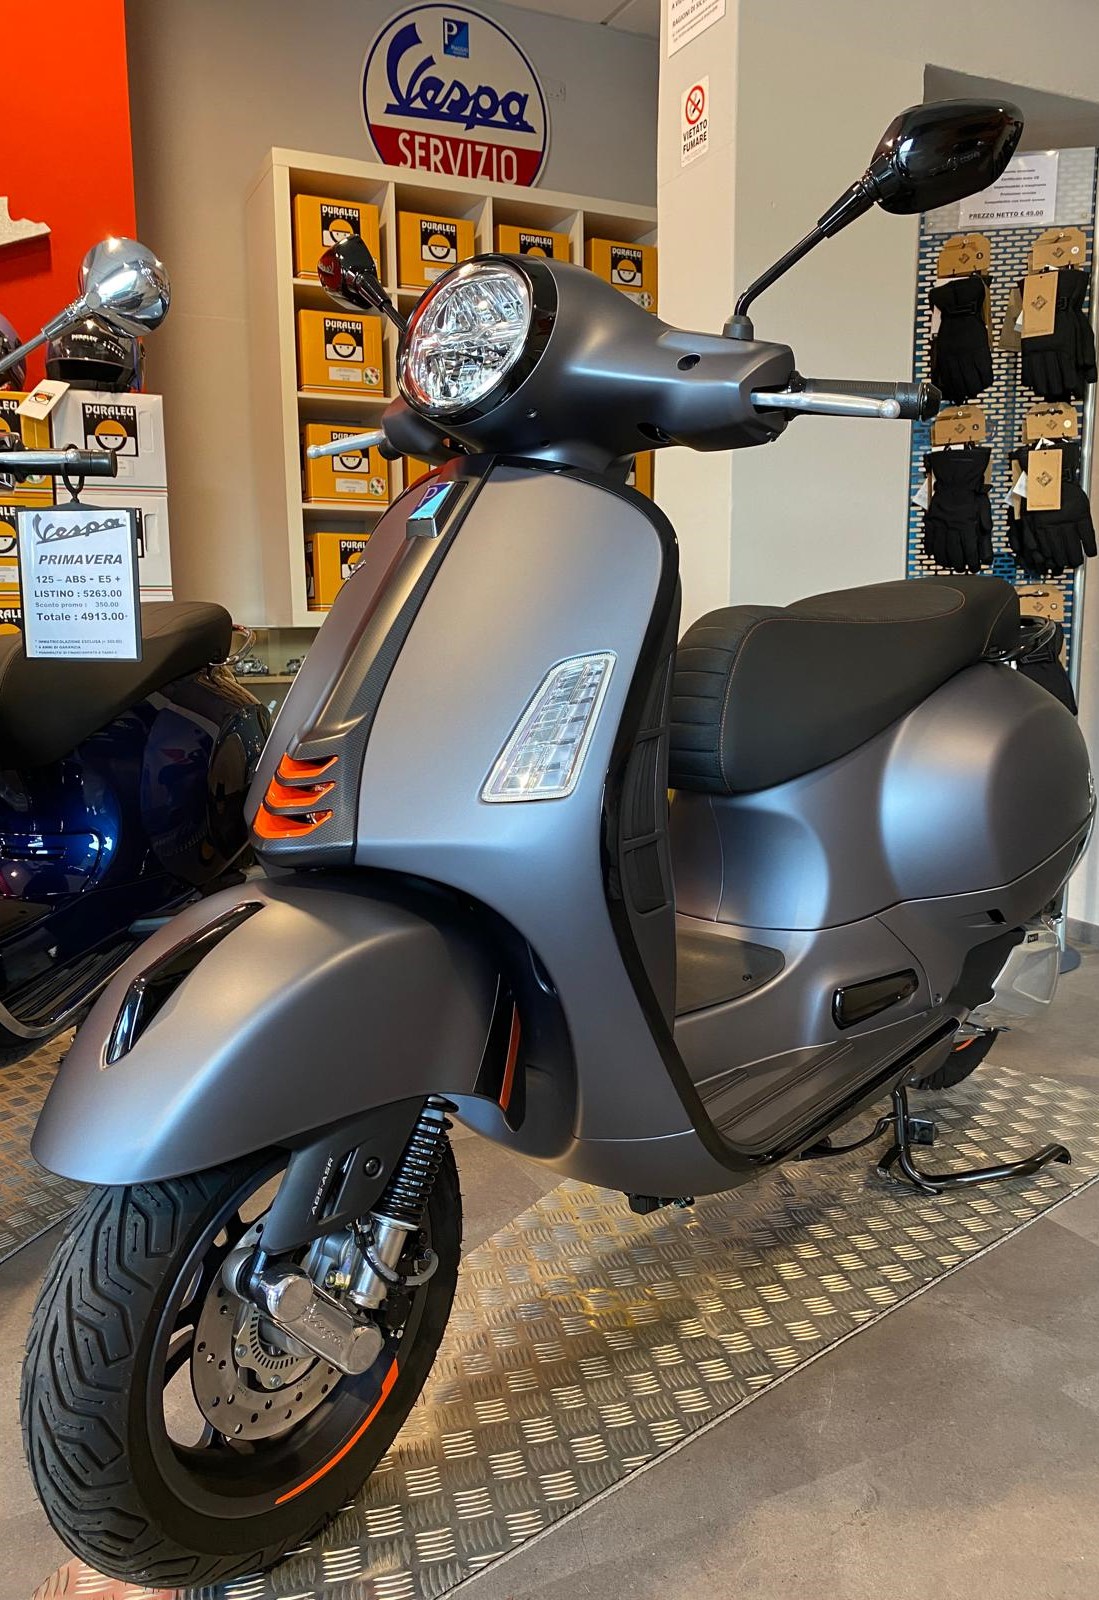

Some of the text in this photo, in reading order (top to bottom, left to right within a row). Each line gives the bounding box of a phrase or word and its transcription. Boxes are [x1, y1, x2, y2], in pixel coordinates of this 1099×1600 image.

[444, 21, 458, 45] P
[384, 22, 537, 133] Vespa
[682, 119, 708, 142] VIETATO
[682, 131, 708, 154] FUMARE
[398, 132, 518, 185] SERVIZIO
[322, 205, 358, 217] DURALEU
[968, 212, 994, 220] PREZZO
[422, 221, 455, 233] DURALEU
[520, 234, 552, 245] DURALEU
[325, 320, 361, 330] DURALEU
[85, 405, 133, 416] DURALEU
[418, 487, 438, 507] P
[32, 513, 126, 545] Vespa
[38, 554, 122, 565] PRIMAVERA
[36, 613, 70, 621] Totale
